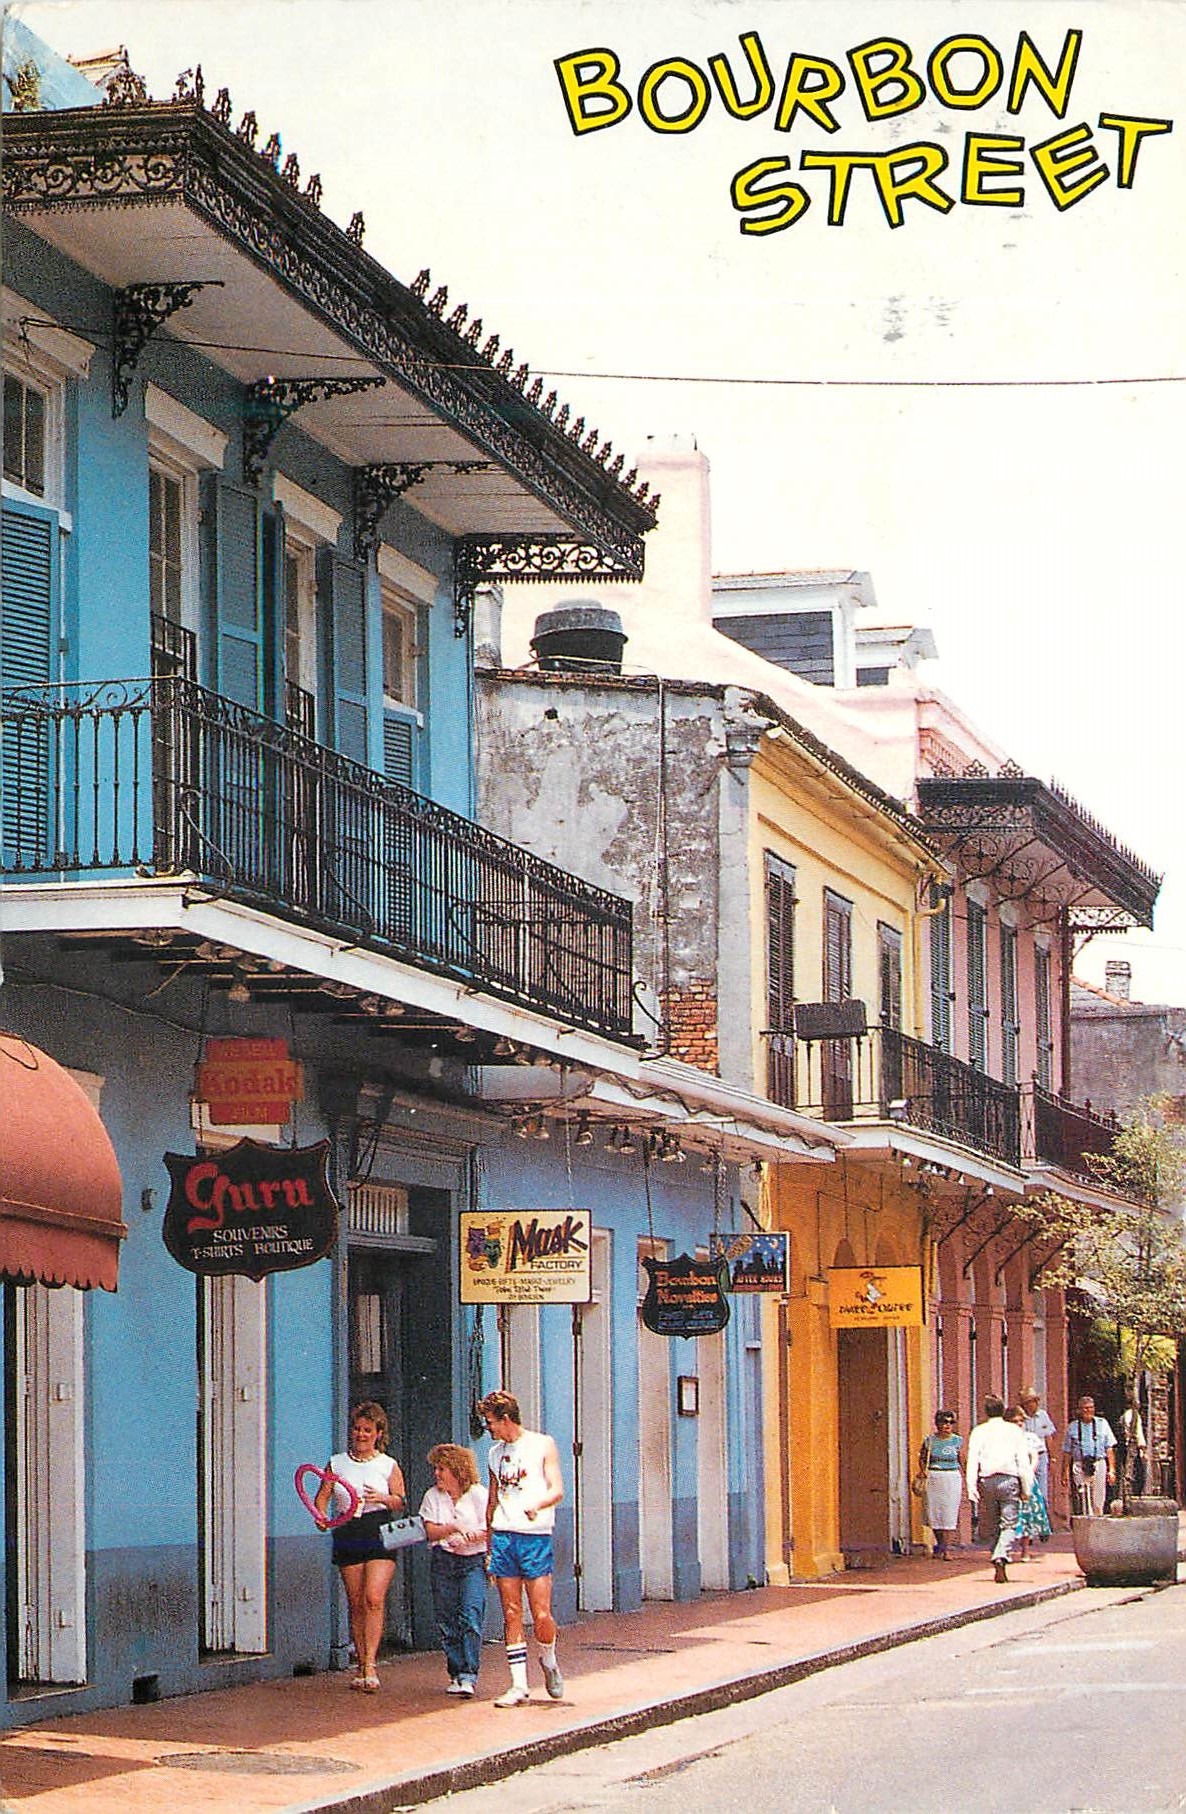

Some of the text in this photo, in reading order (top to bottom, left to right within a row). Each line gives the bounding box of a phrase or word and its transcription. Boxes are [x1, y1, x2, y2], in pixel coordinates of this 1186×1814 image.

[186, 1162, 314, 1234] Guru
[192, 1237, 314, 1260] T-SHIRTS BOUTIQUE
[505, 1216, 588, 1272] Mask
[530, 1260, 583, 1270] FACTORY
